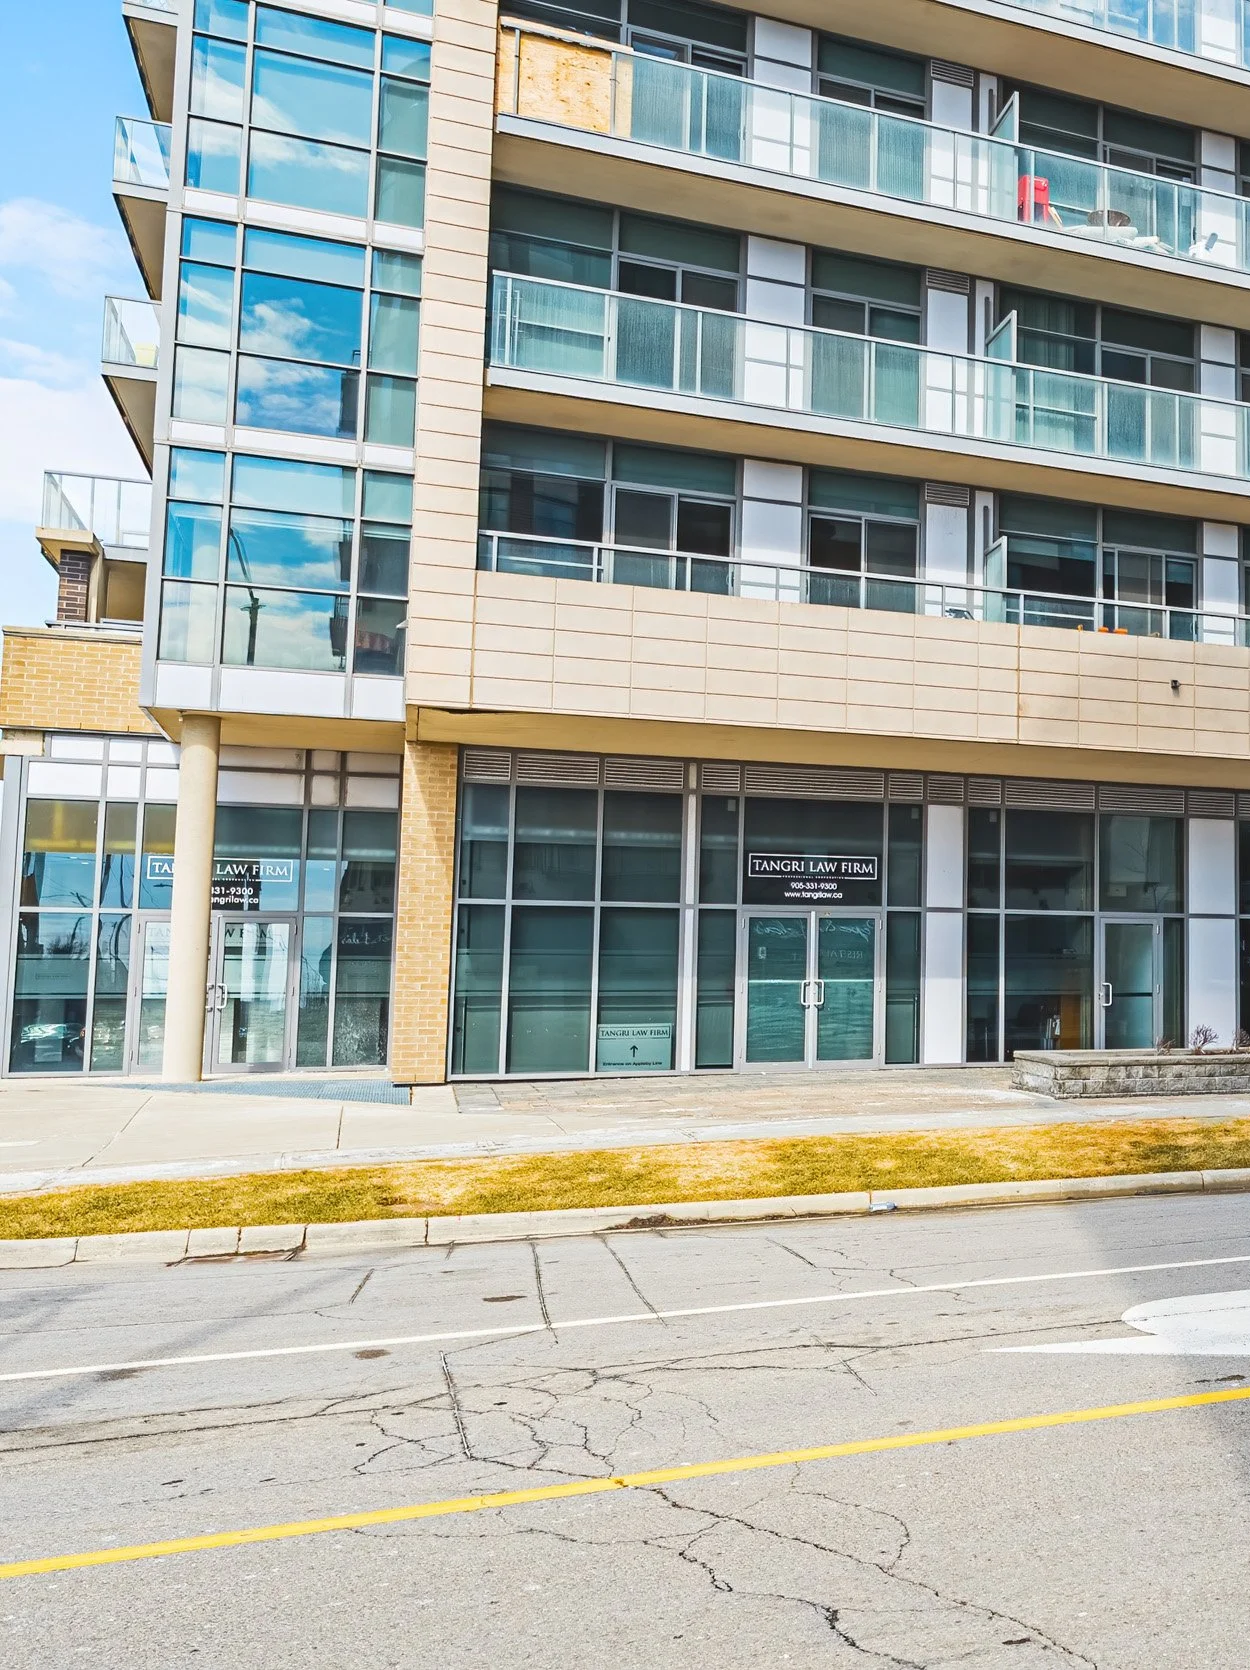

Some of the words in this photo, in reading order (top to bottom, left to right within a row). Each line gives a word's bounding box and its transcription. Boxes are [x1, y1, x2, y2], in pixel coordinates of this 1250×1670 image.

[216, 863, 248, 875] LAW
[252, 864, 289, 876] FIRM
[752, 859, 805, 872] TANGRI
[809, 861, 838, 873] LAW
[841, 862, 874, 874] FIRM
[790, 882, 838, 890] 905-331-9300
